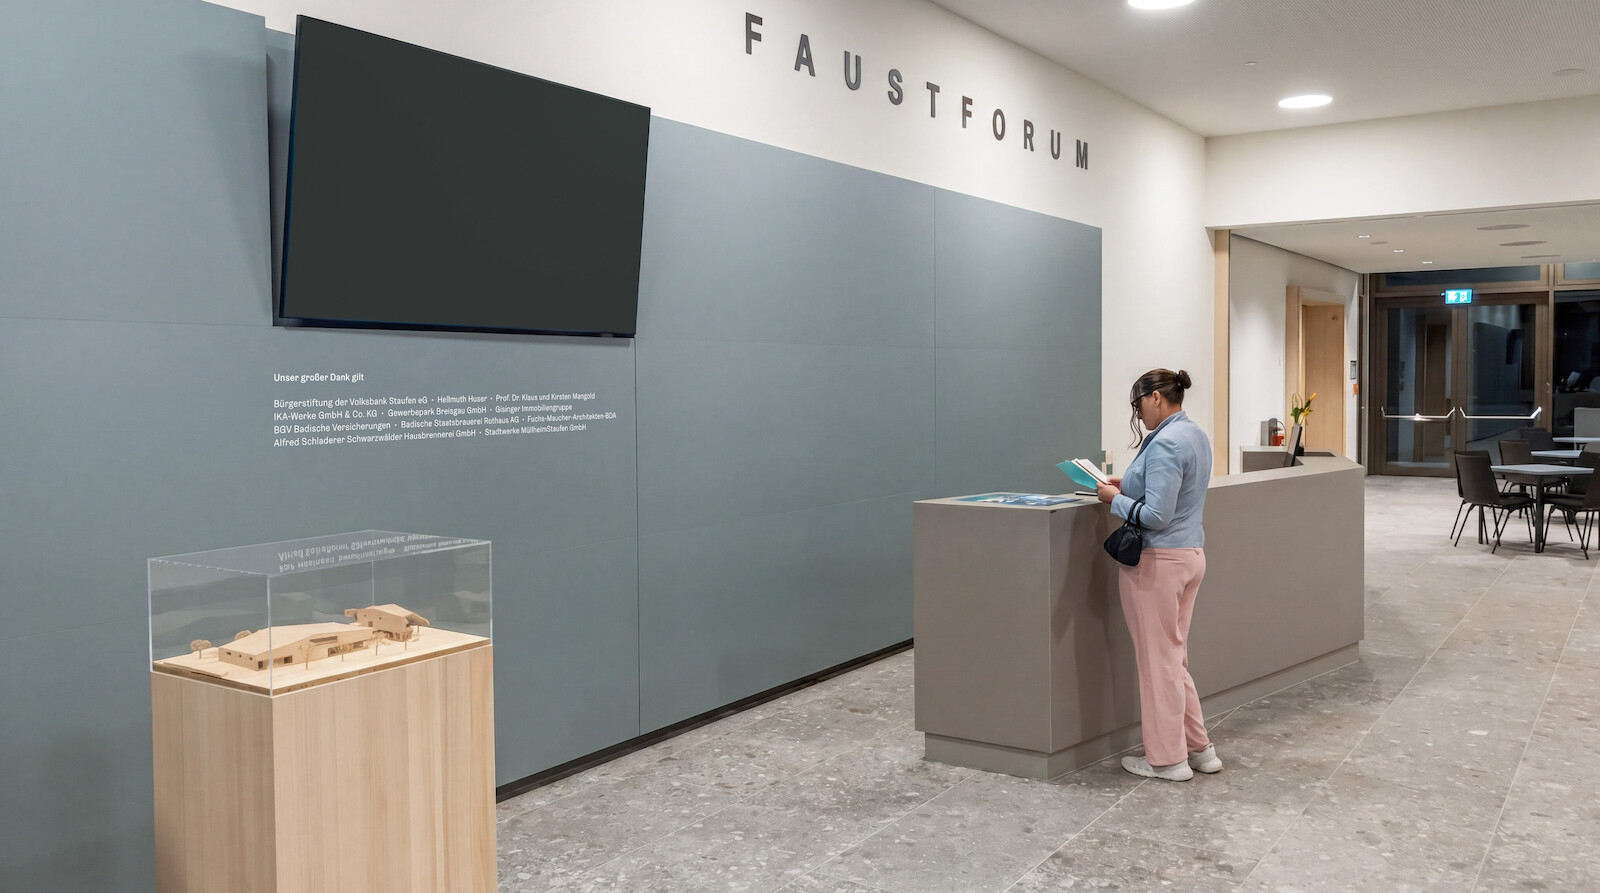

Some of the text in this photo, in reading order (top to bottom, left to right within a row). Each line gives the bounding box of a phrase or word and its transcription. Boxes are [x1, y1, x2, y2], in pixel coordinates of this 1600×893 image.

[745, 12, 1089, 170] FAUSTFORUM
[274, 373, 364, 383] Unser großer Dank gilt
[274, 398, 333, 409] Bürgerstiftung
[349, 397, 387, 406] Volksbank
[389, 396, 416, 405] Staufen
[274, 412, 316, 421] IKA-Werke
[318, 411, 342, 419] GmbH
[352, 410, 365, 418] Co.
[388, 408, 435, 417] Gewerbepark
[436, 407, 465, 416] Breisgau
[495, 406, 520, 414] Gisinger
[274, 425, 292, 434] BGV
[294, 424, 330, 433] Badische
[332, 423, 391, 431] Versicherungen
[401, 420, 432, 428] Badische
[274, 438, 299, 447] Alfred
[302, 436, 345, 446] Schladerer
[347, 433, 403, 443] Schwarzwälder
[485, 427, 520, 436] Stadtwerke
